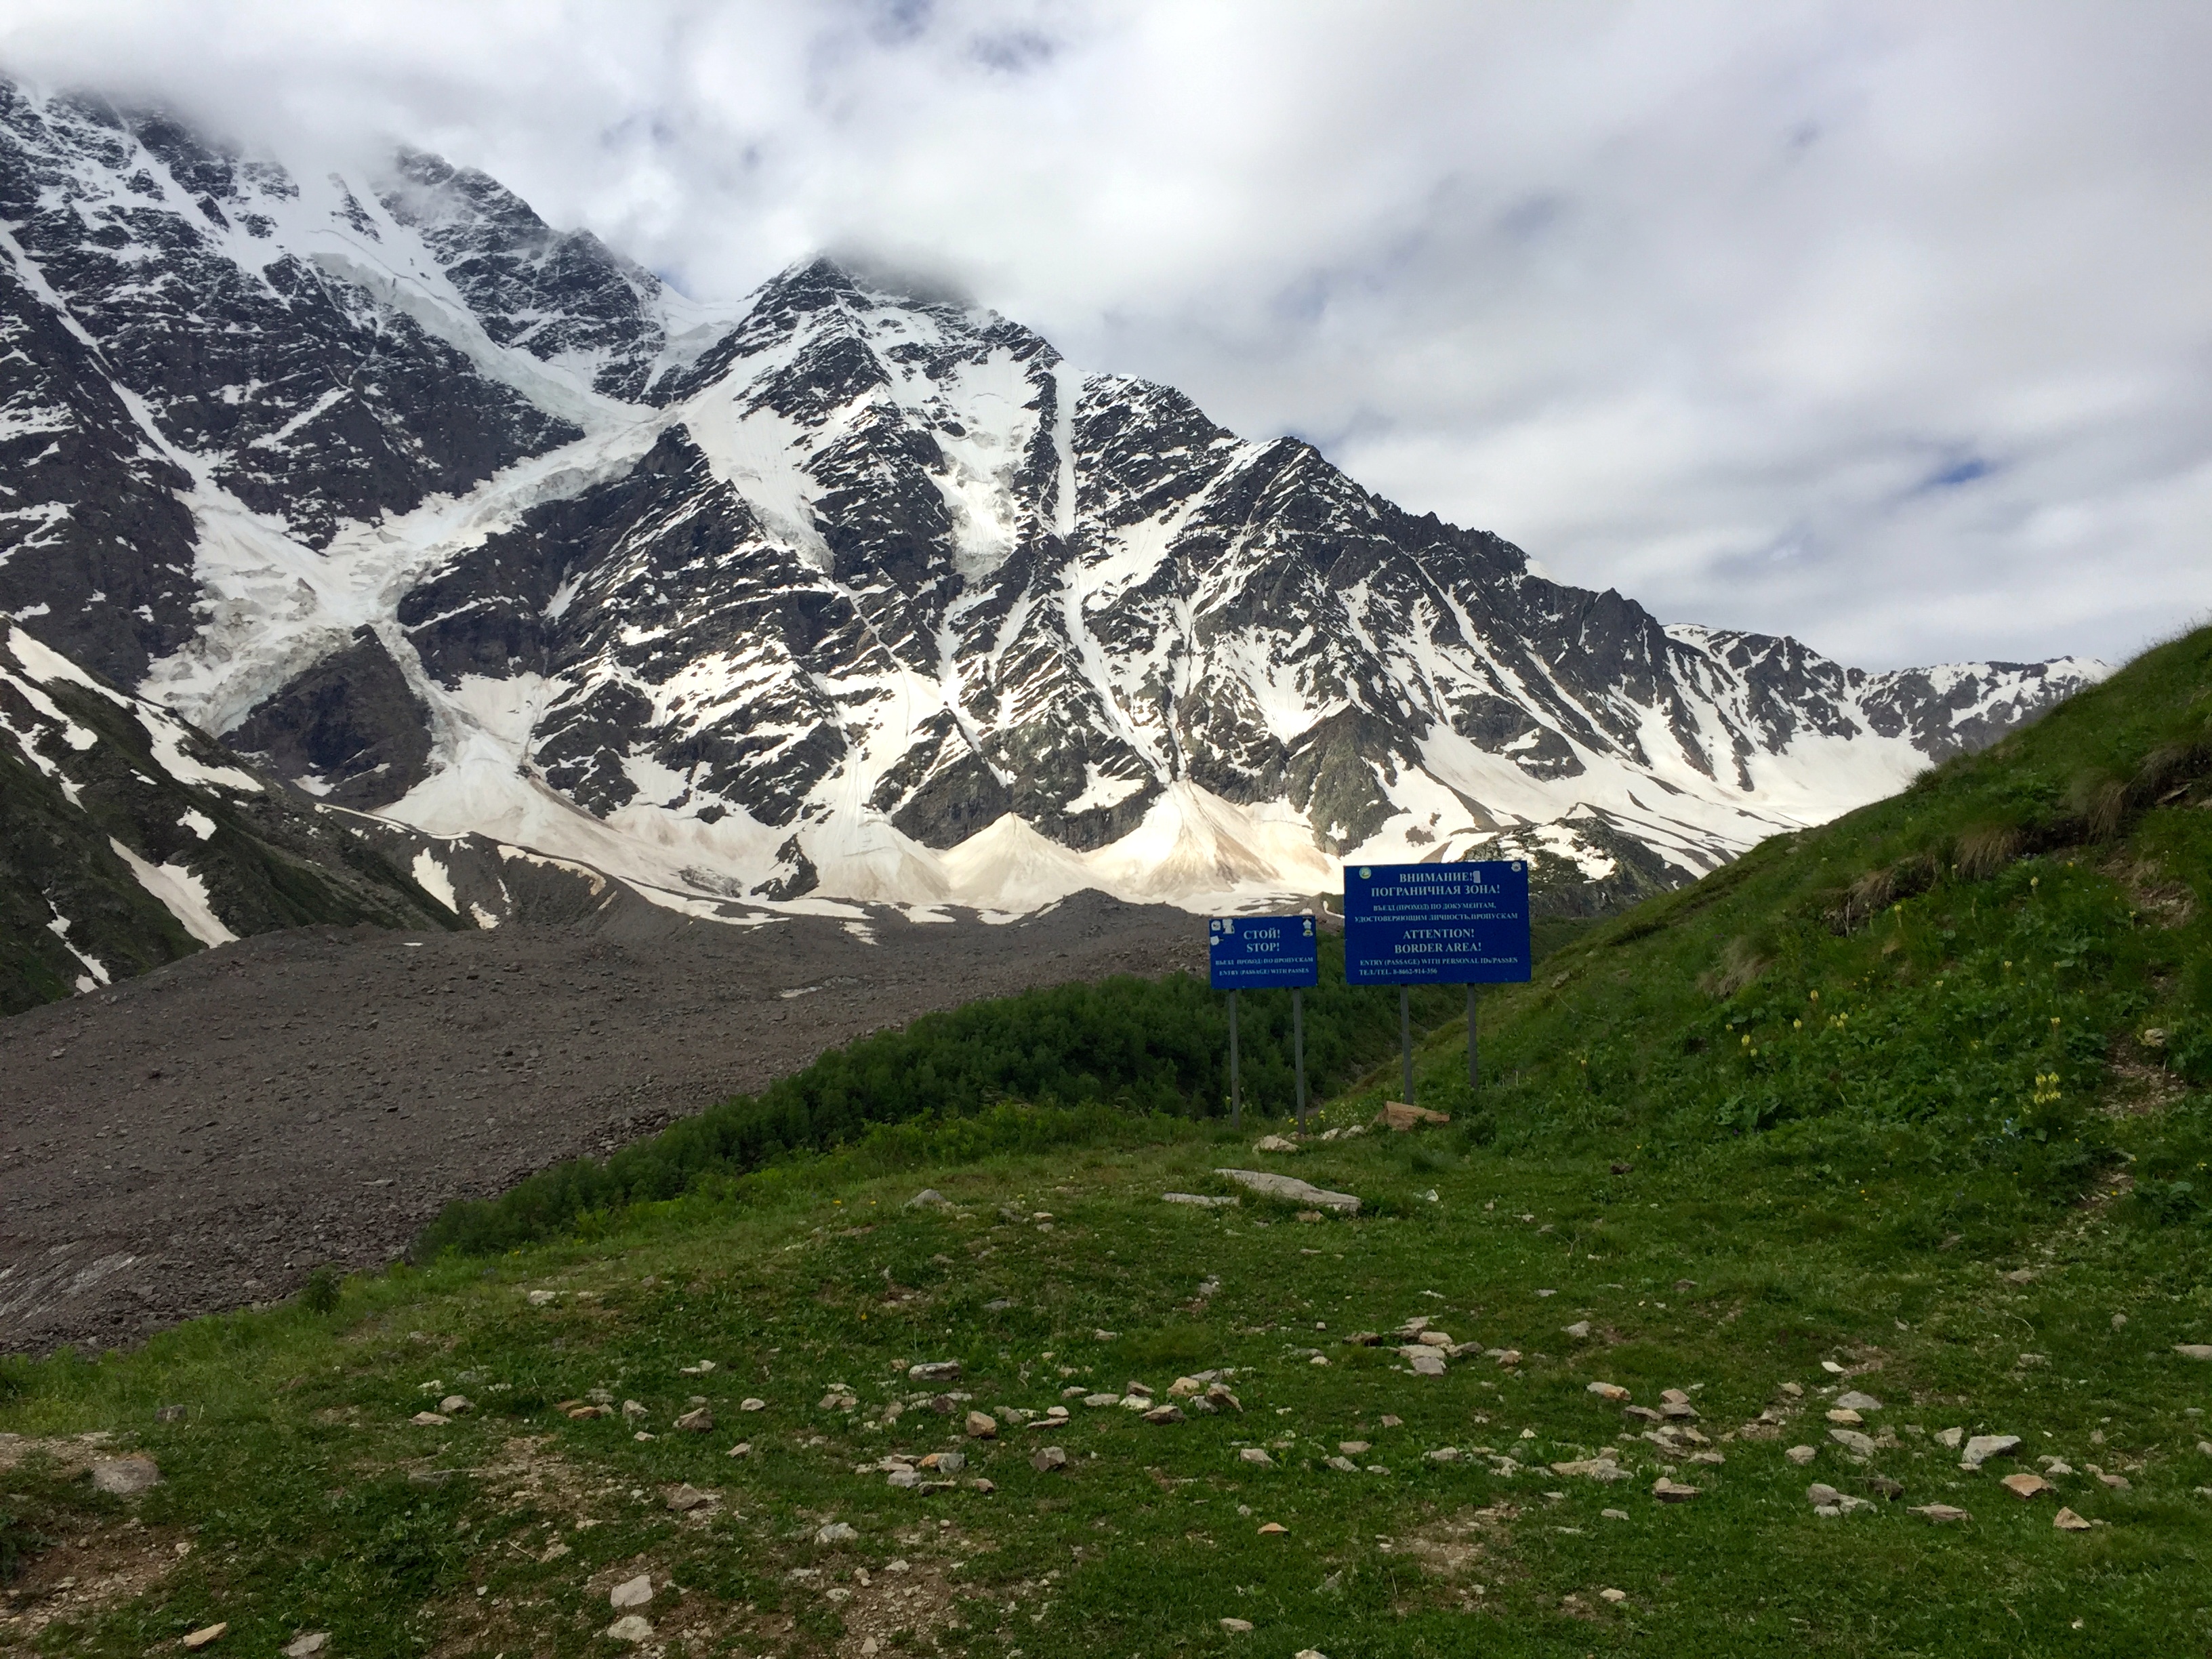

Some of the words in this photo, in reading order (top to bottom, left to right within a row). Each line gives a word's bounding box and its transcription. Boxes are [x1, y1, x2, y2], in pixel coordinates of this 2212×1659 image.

[1399, 872, 1473, 883] ВНИМАНИЕ!
[1371, 885, 1461, 897] ПОГРАНИЧНАЯ
[1464, 884, 1500, 895] ЗОНА!
[1244, 928, 1280, 940] СТОЙ!
[1403, 928, 1475, 939] ATTENTION!
[1246, 943, 1279, 952] STOP!
[1395, 943, 1443, 954] BORDER
[1446, 943, 1481, 952] AREA!
